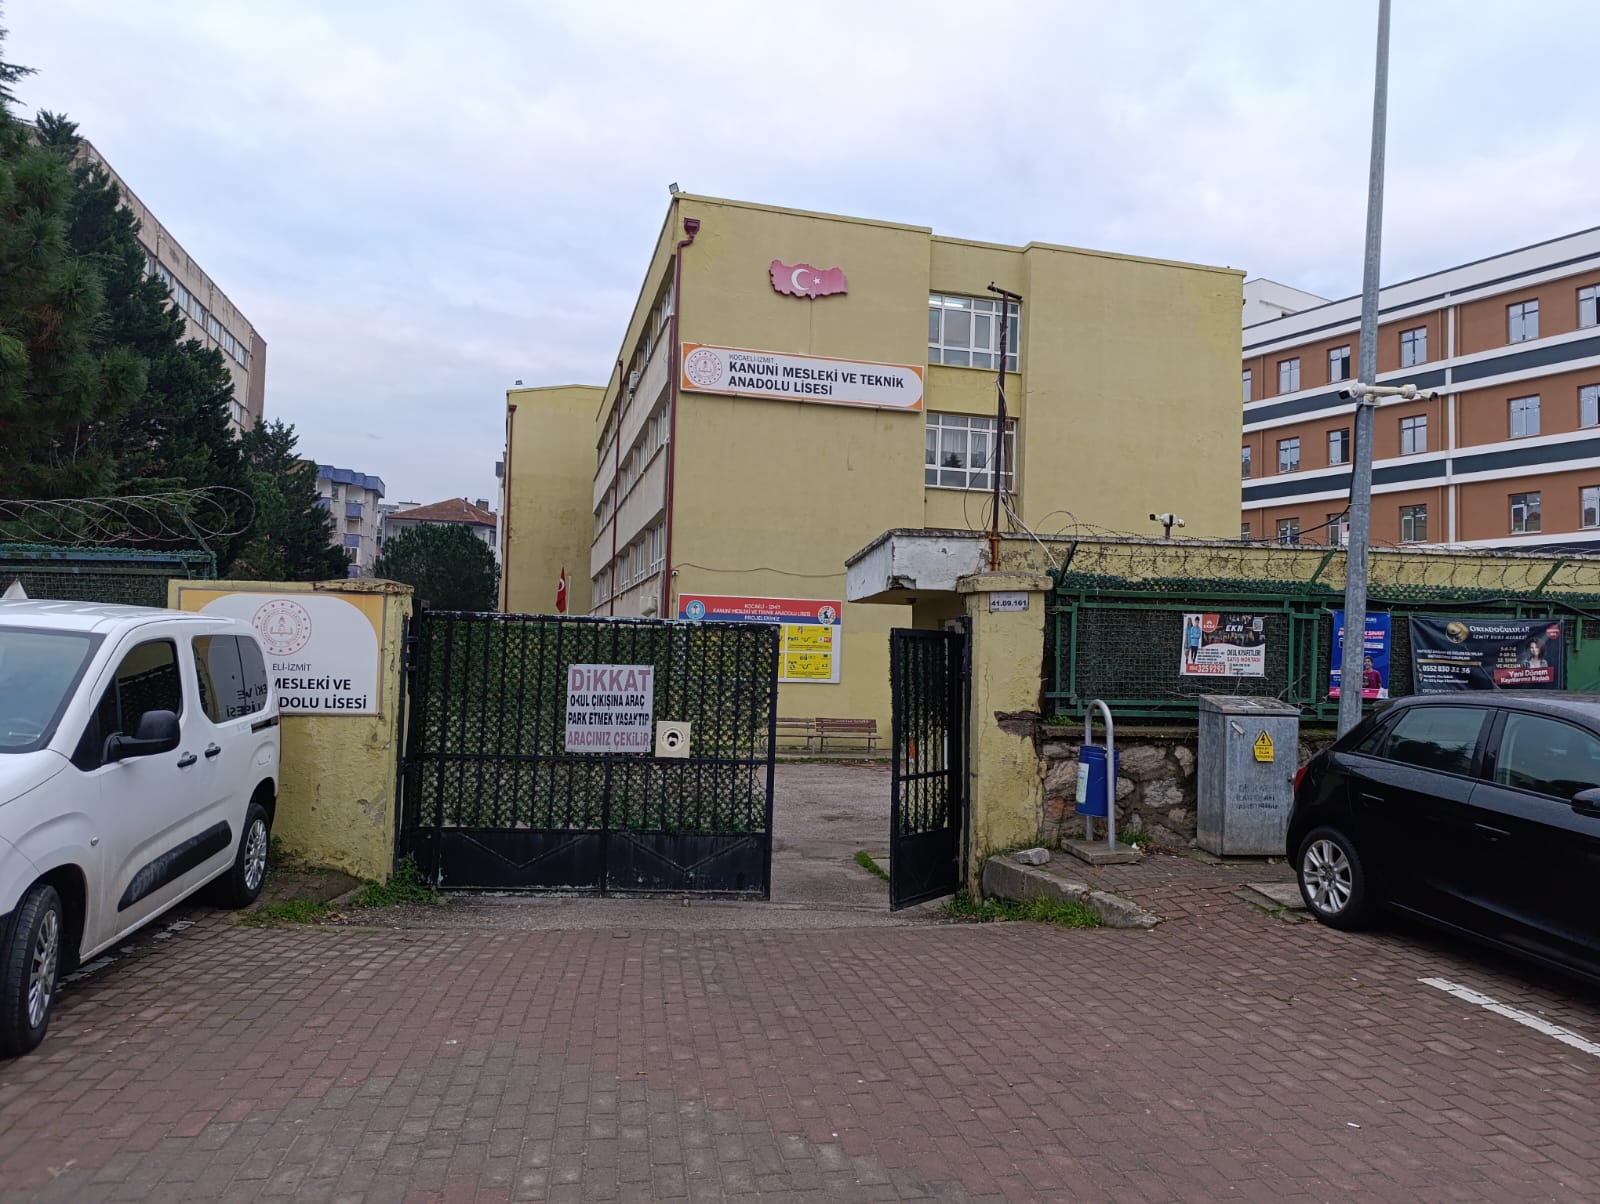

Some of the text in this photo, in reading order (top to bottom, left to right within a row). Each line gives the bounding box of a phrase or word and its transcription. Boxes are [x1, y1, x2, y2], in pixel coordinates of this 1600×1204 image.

[729, 361, 778, 376] KANUNİ
[783, 366, 837, 382] MESLEKİ
[841, 372, 857, 384] VE
[860, 374, 904, 388] TEKNİK
[728, 376, 832, 395] ANADOLU LİSESİ
[272, 663, 312, 672] ELİ-İZMİT
[1509, 669, 1548, 678] Yeni Dönem
[333, 679, 351, 690] VE
[279, 694, 367, 710] DOLU LİSESİ
[570, 694, 645, 710] OKUL ÇIKIŞINA ARAÇ
[567, 712, 587, 725] PARK
[589, 712, 613, 726] ETMEK
[567, 731, 612, 747] ARACINIZ
